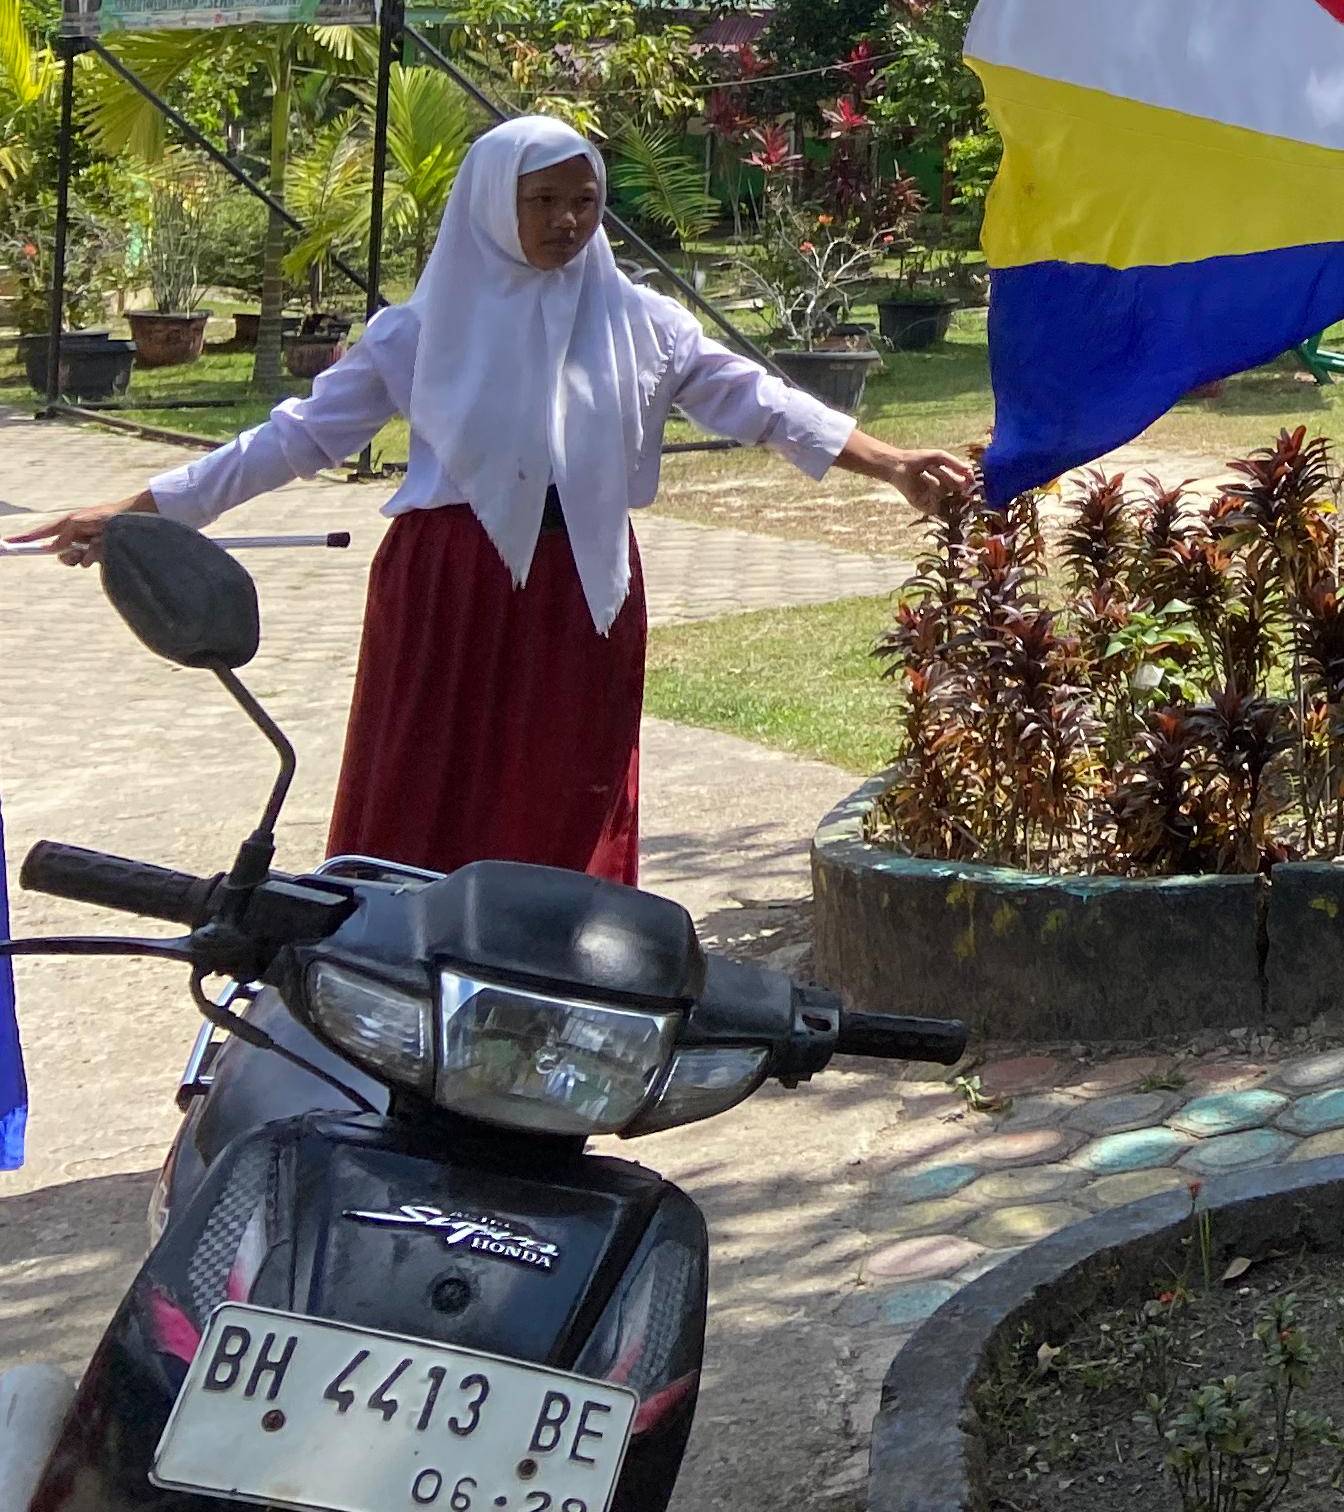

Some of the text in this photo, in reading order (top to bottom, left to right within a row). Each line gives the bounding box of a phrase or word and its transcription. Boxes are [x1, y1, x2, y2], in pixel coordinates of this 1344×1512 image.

[342, 1205, 559, 1257] Supra
[471, 1238, 551, 1267] HONDA
[202, 1325, 612, 1464] BH 4413 BE
